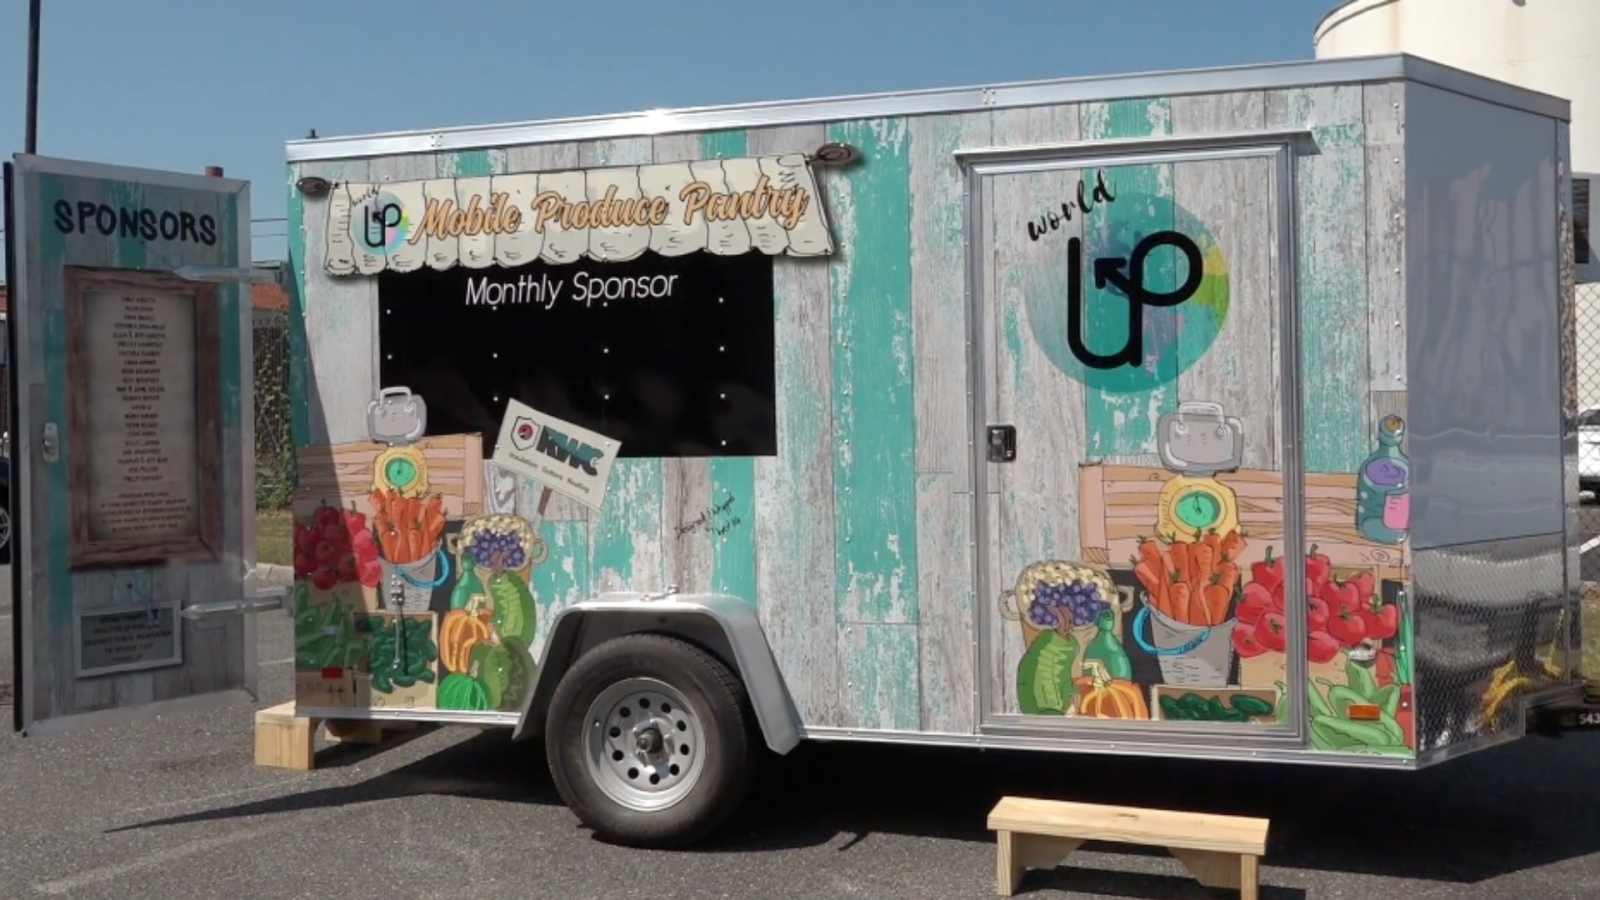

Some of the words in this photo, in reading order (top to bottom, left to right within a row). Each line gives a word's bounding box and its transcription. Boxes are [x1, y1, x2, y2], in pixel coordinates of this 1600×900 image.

[53, 199, 217, 246] SPONSORS
[408, 193, 522, 244] Mobile
[531, 184, 667, 234] Produce
[680, 173, 810, 231] Pantry
[1027, 168, 1116, 241] world
[465, 272, 563, 309] Monthly
[573, 271, 678, 305] Sponsor
[508, 452, 539, 469] Insulation
[541, 465, 563, 481] Gutters
[567, 477, 590, 494] Roofing
